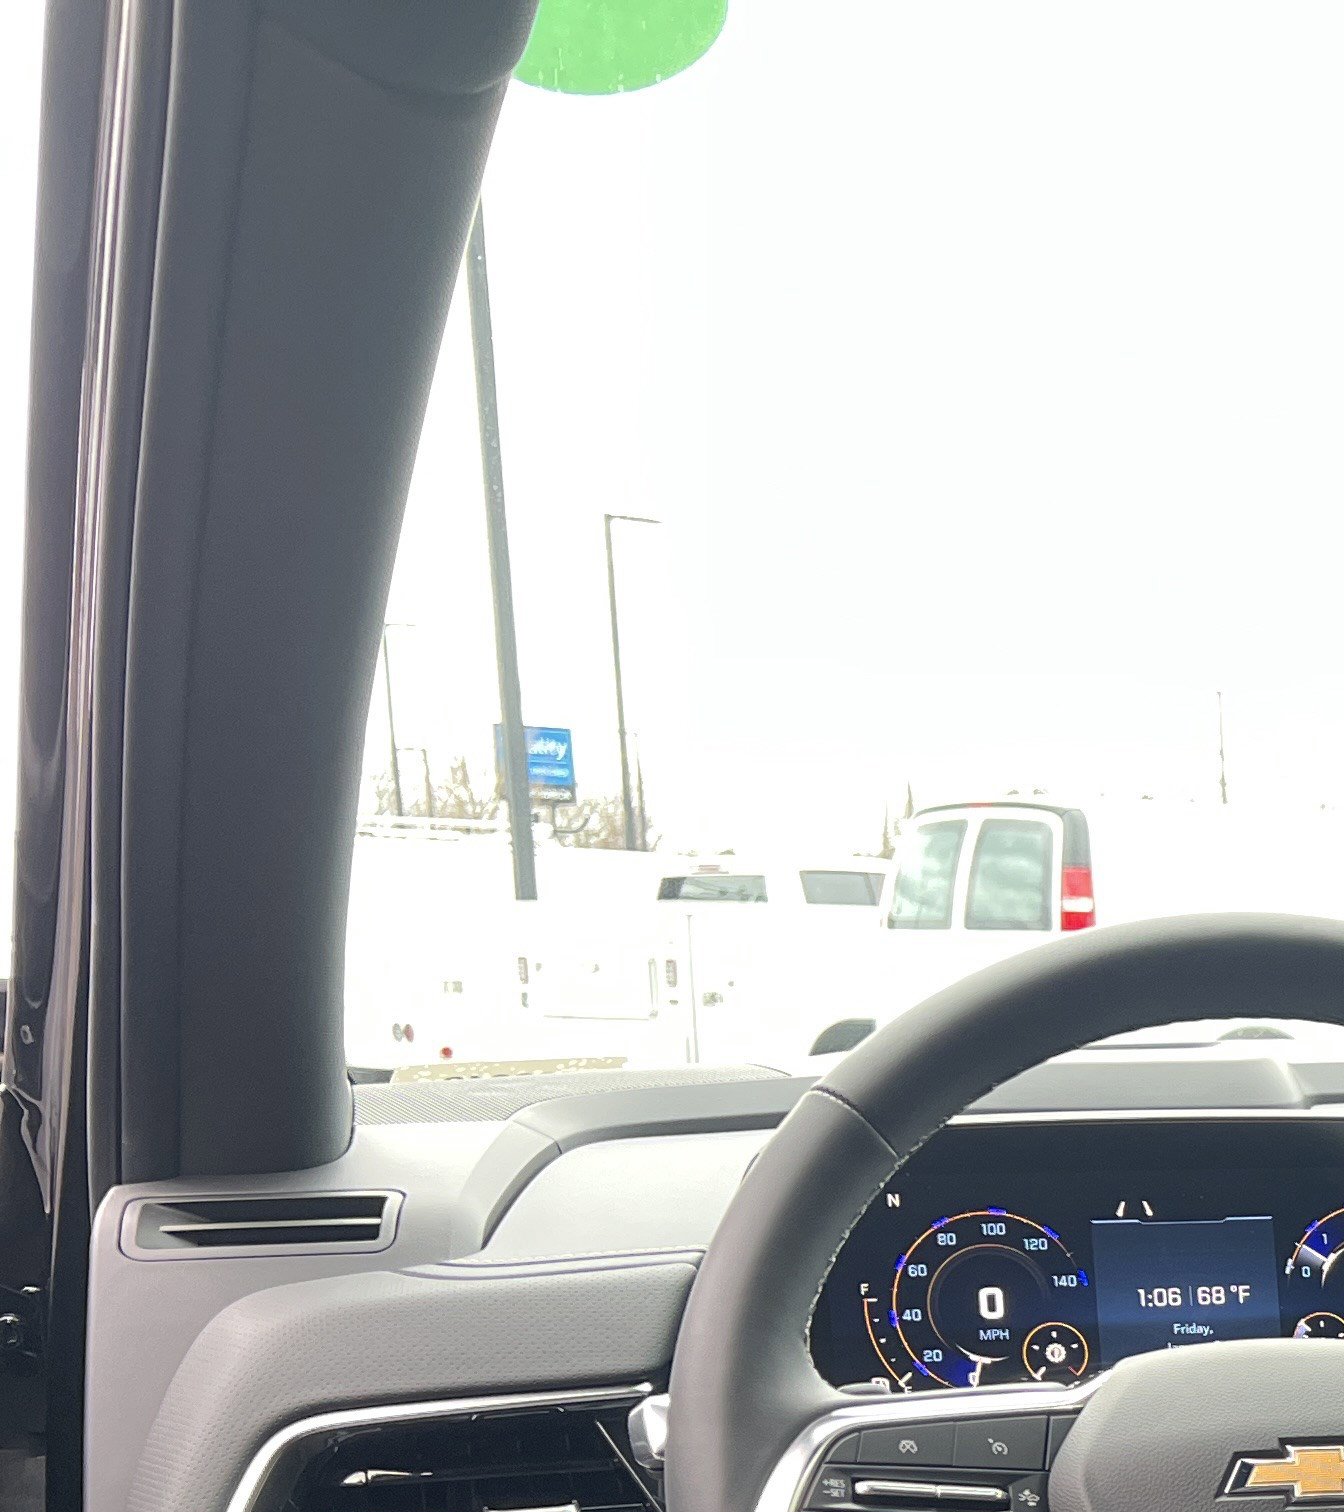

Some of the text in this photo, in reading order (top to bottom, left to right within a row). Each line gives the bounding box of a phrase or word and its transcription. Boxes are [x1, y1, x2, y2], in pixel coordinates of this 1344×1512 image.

[886, 1193, 900, 1208] N
[980, 1223, 1006, 1236] 100
[936, 1233, 957, 1246] 80
[1023, 1238, 1048, 1250] 120
[1321, 1233, 1329, 1245] 1
[908, 1264, 928, 1277] 60
[1051, 1275, 1078, 1287] 140
[860, 1283, 869, 1295] F
[977, 1286, 1005, 1320] 0
[1137, 1287, 1182, 1308] 1:06
[1196, 1285, 1226, 1305] 68
[902, 1309, 922, 1322] 40
[979, 1329, 1010, 1341] MPH
[923, 1349, 943, 1362] 20
